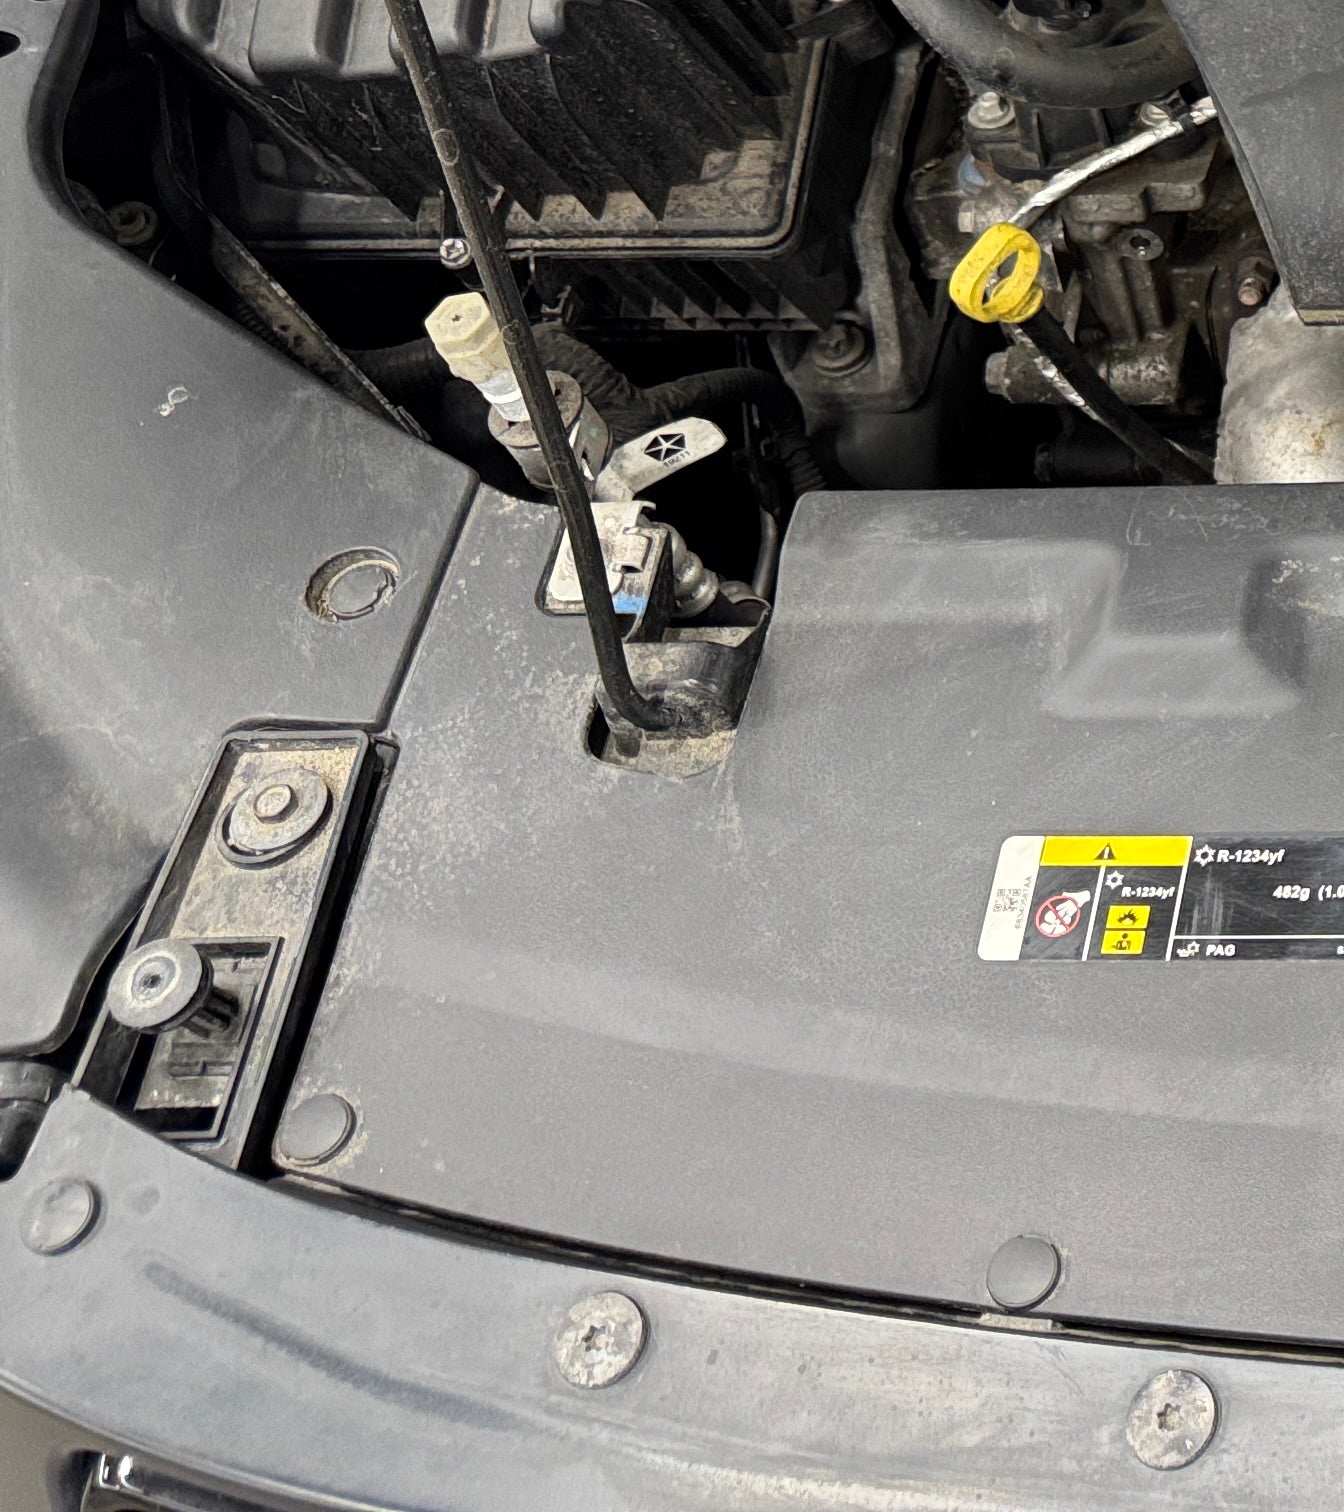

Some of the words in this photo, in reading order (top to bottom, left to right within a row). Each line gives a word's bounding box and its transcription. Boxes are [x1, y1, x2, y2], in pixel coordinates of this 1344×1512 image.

[1216, 848, 1286, 866] R-1234yf
[1121, 886, 1175, 899] R-1234yf
[1272, 884, 1311, 902] 482g
[1205, 943, 1236, 956] PAG
